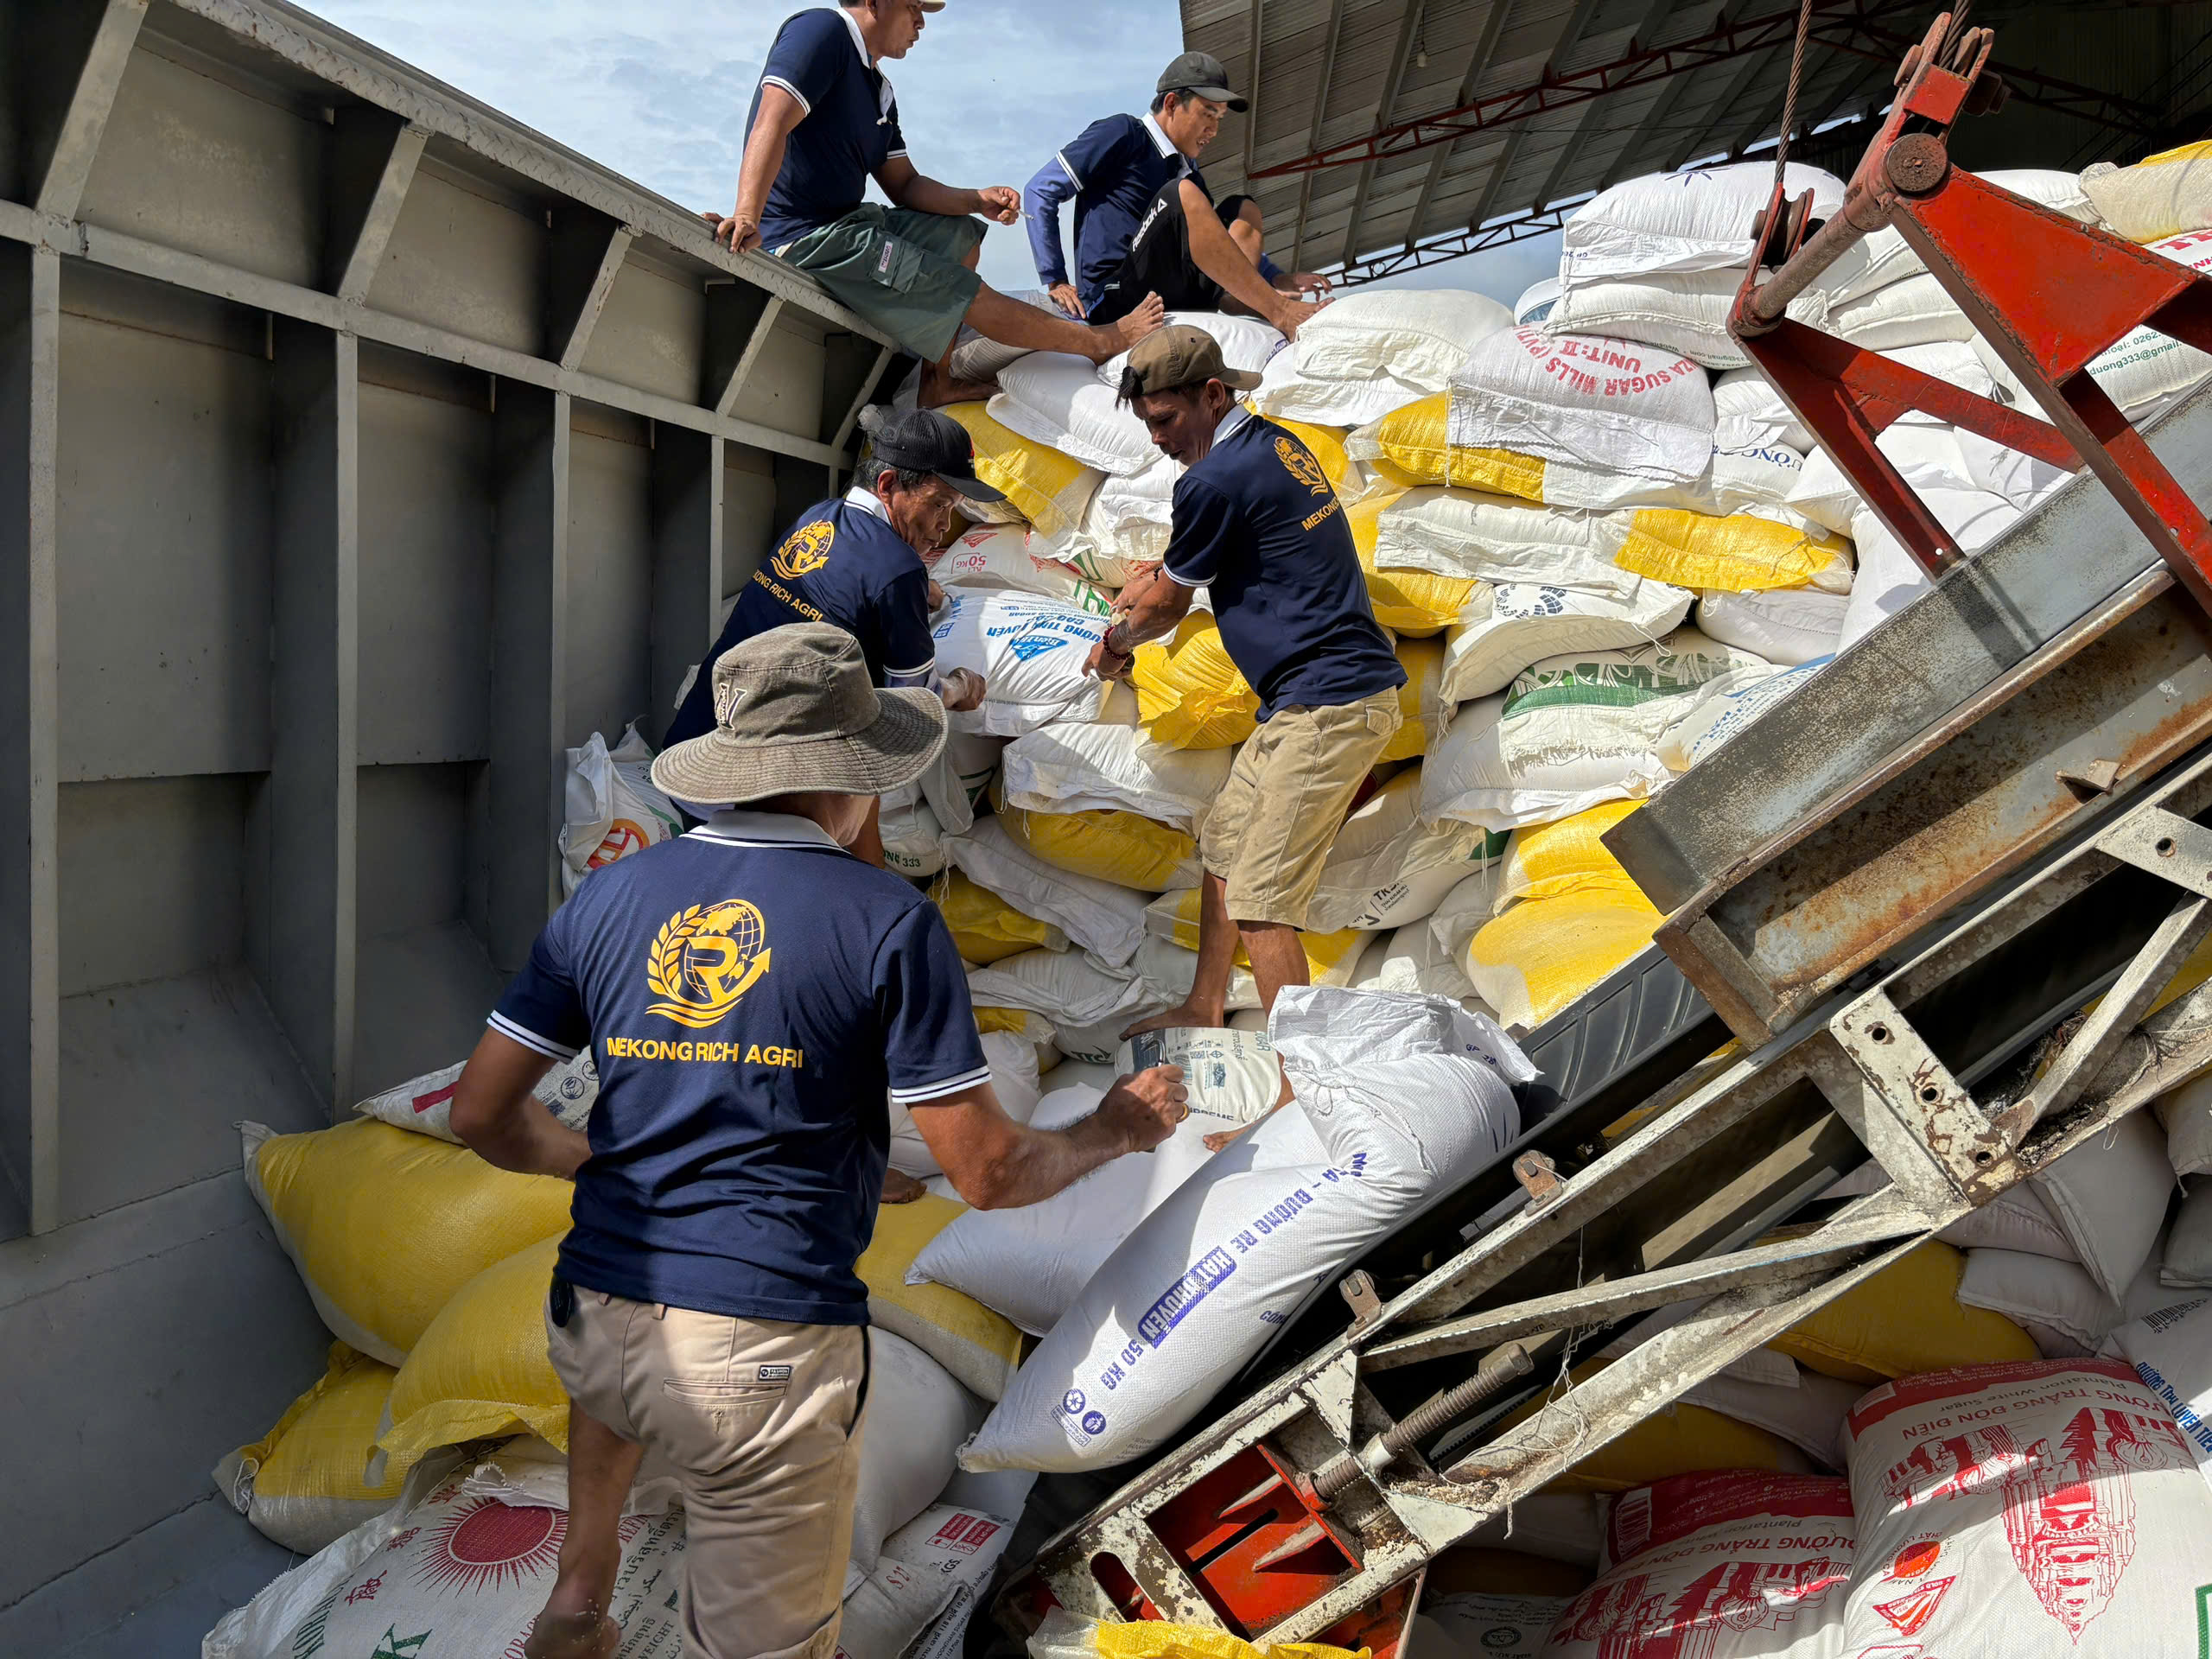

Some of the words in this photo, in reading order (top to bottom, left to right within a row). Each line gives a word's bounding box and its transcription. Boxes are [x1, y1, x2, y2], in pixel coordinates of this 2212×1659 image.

[1133, 207, 1157, 251] Reebok
[1545, 356, 1599, 395] MILLS
[1605, 369, 1672, 397] SUGAR
[769, 582, 792, 602] RICH
[790, 598, 823, 621] AGRI
[1063, 626, 1103, 643] ƯỜNG
[902, 857, 921, 868] 333
[696, 1042, 740, 1062] RICH
[744, 1044, 804, 1069] AGRI
[1465, 1043, 1480, 1052] GP
[1121, 1339, 1144, 1366] 50
[1099, 1361, 1127, 1390] KG
[2038, 1376, 2127, 1392] Plantation
[1939, 1397, 1983, 1413] Sugar
[1986, 1387, 2035, 1403] White
[2012, 1388, 2092, 1411] TRẮNG
[2094, 1389, 2167, 1413] ƯỜNG
[1700, 1537, 1771, 1554] TRẮNG
